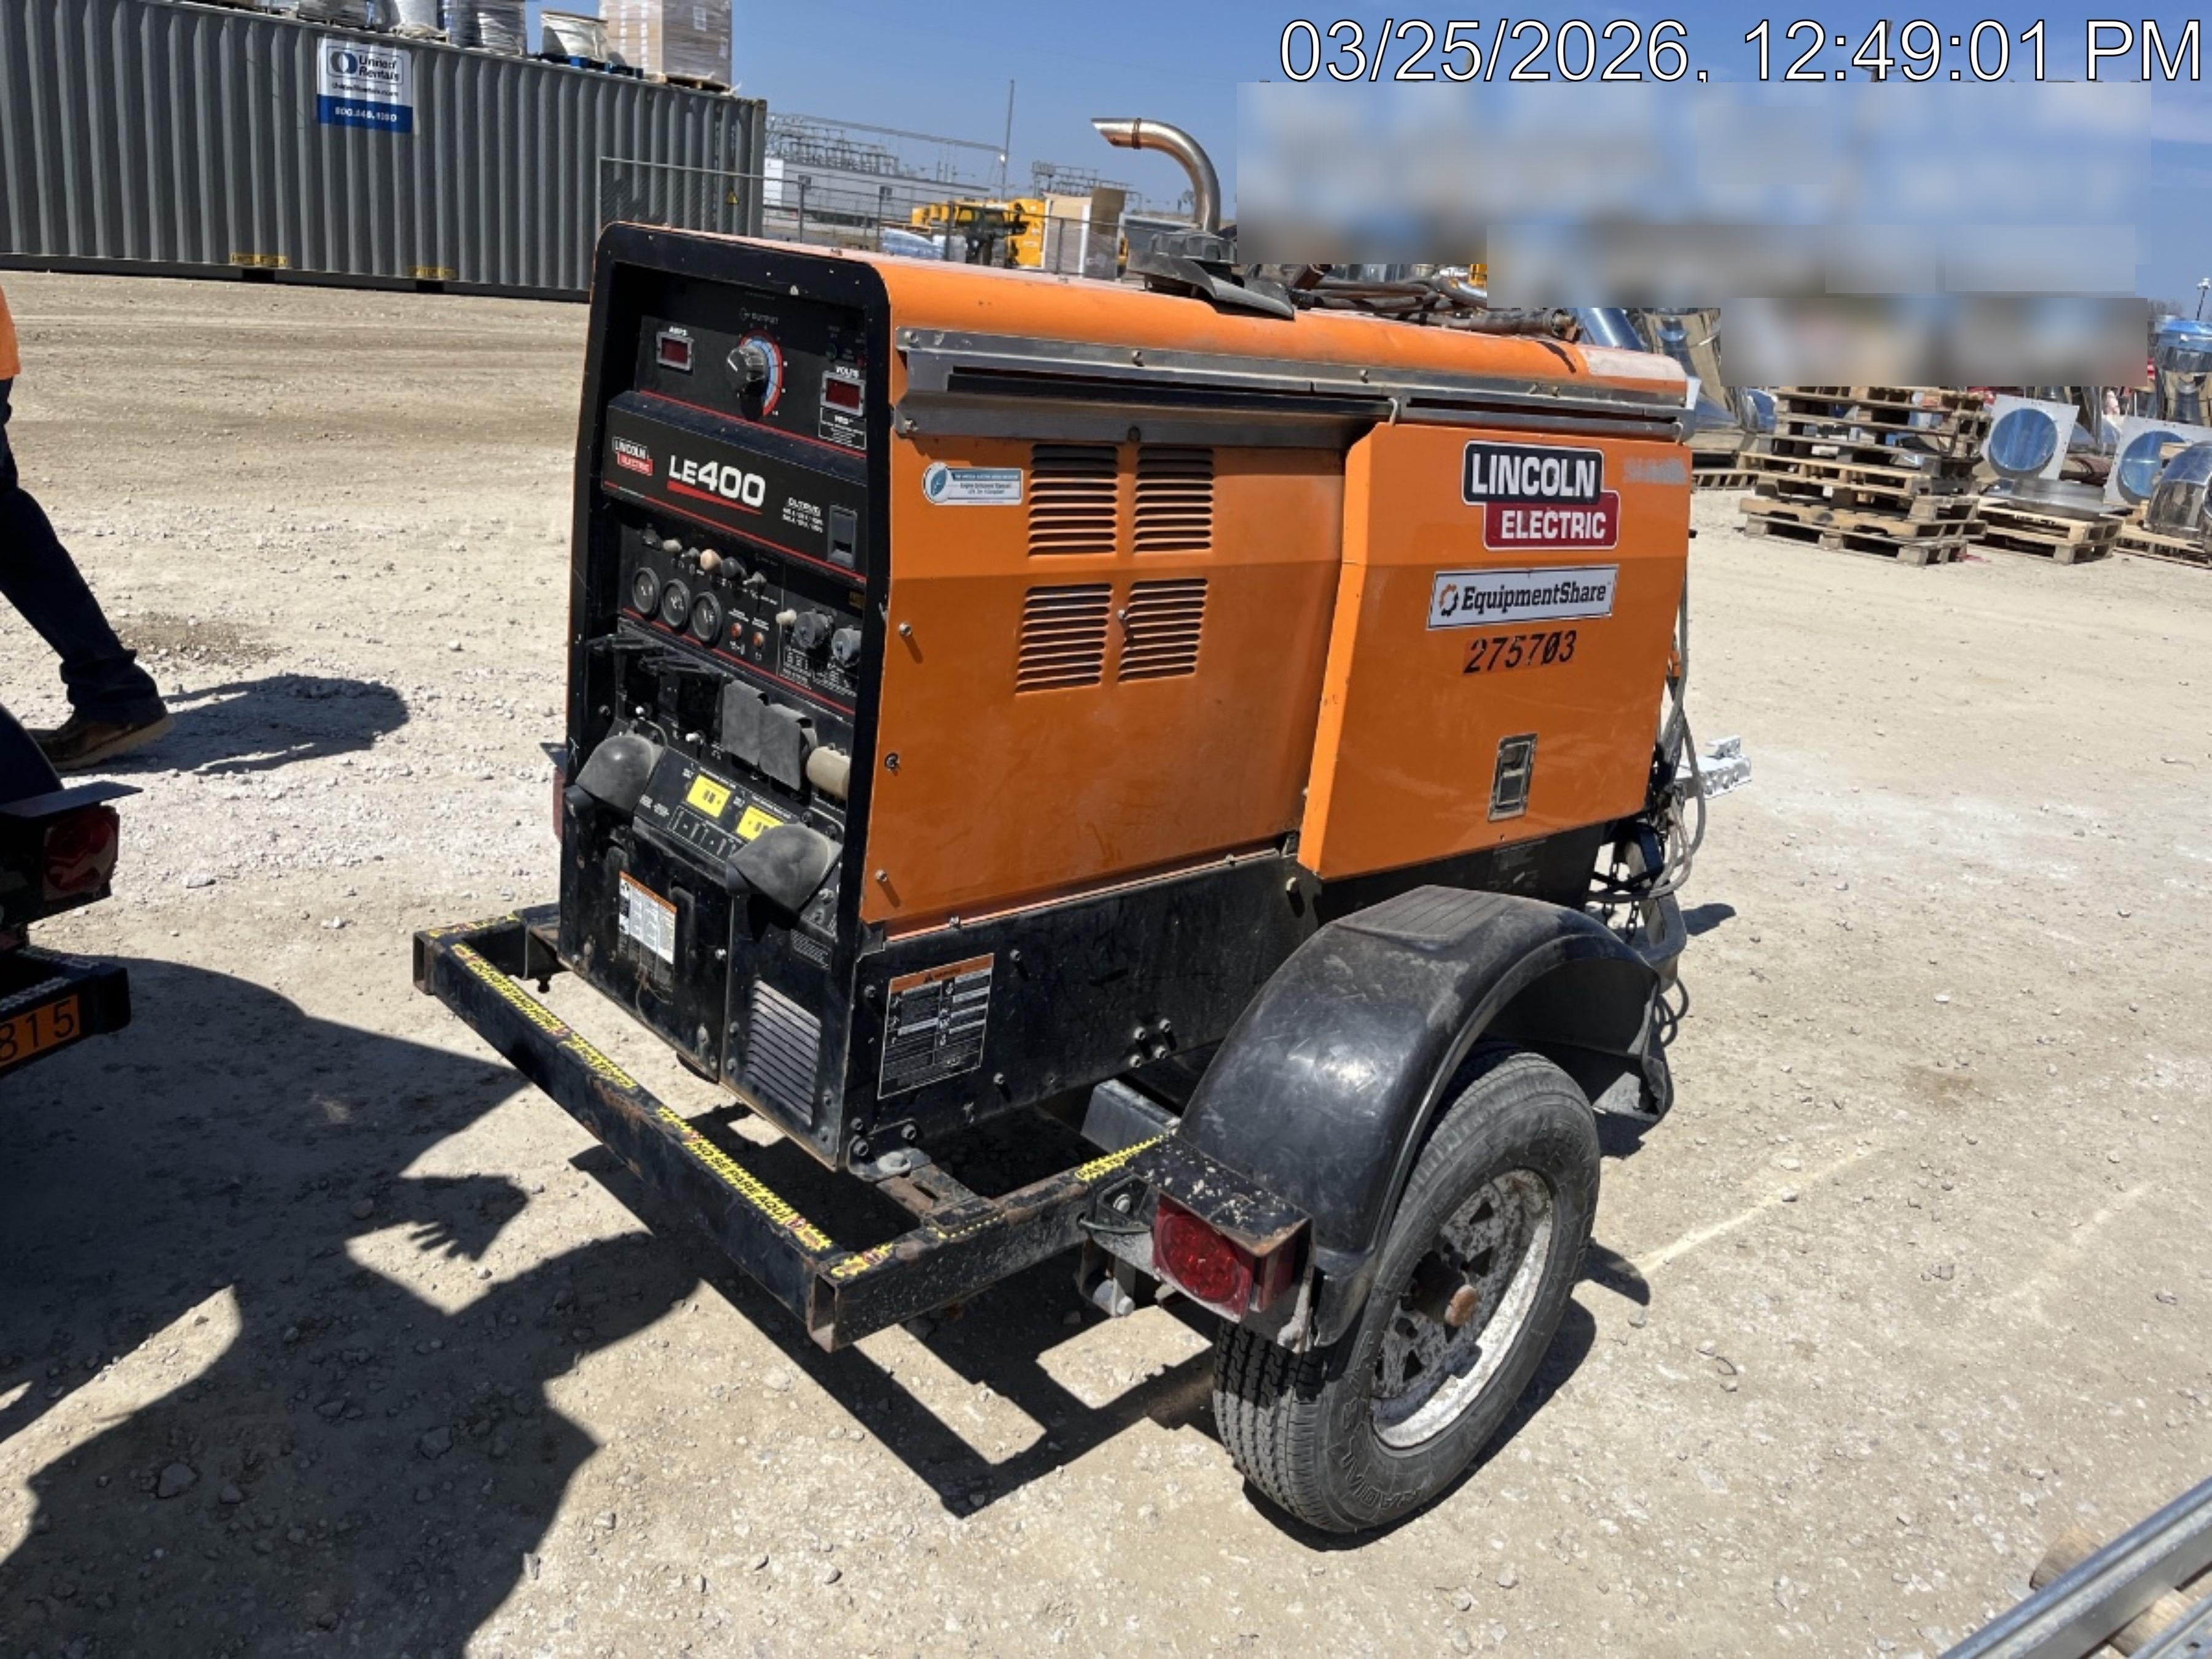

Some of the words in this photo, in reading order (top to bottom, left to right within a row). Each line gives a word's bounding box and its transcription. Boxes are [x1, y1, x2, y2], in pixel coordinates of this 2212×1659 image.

[358, 55, 397, 69] United
[358, 66, 399, 81] Rentals
[668, 453, 766, 508] LE400
[1472, 453, 1596, 498] LINCOLN
[1500, 509, 1607, 540] ELECTRIC
[1461, 580, 1607, 615] EquipmentShare
[1463, 629, 1577, 674] 275703
[696, 1142, 713, 1158] NO
[712, 1156, 731, 1170] SE
[729, 1169, 758, 1195] PARE
[758, 1194, 789, 1221] AQUI
